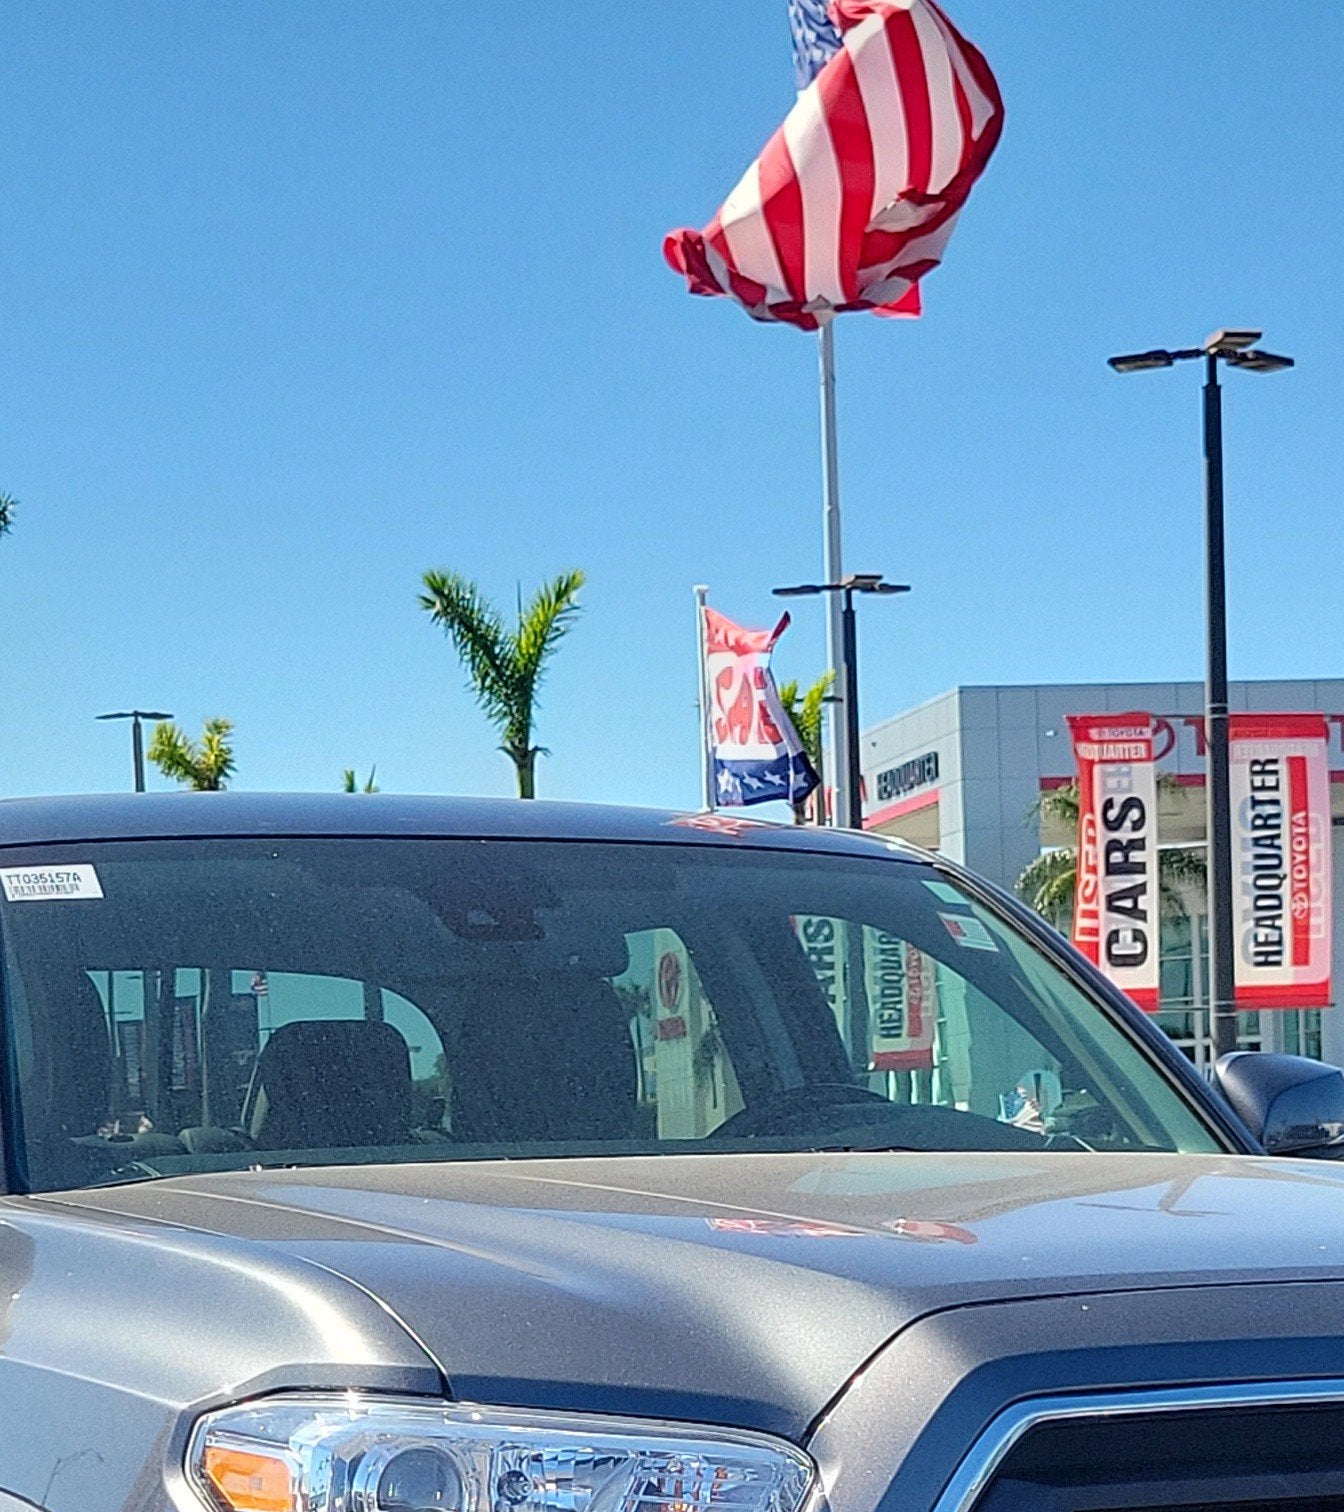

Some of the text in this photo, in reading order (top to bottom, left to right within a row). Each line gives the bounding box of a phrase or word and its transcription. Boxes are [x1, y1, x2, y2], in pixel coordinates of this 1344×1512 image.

[1102, 796, 1148, 968] CARS
[1250, 757, 1288, 968] HEADQUARTER
[1291, 811, 1309, 888] TOYOTA
